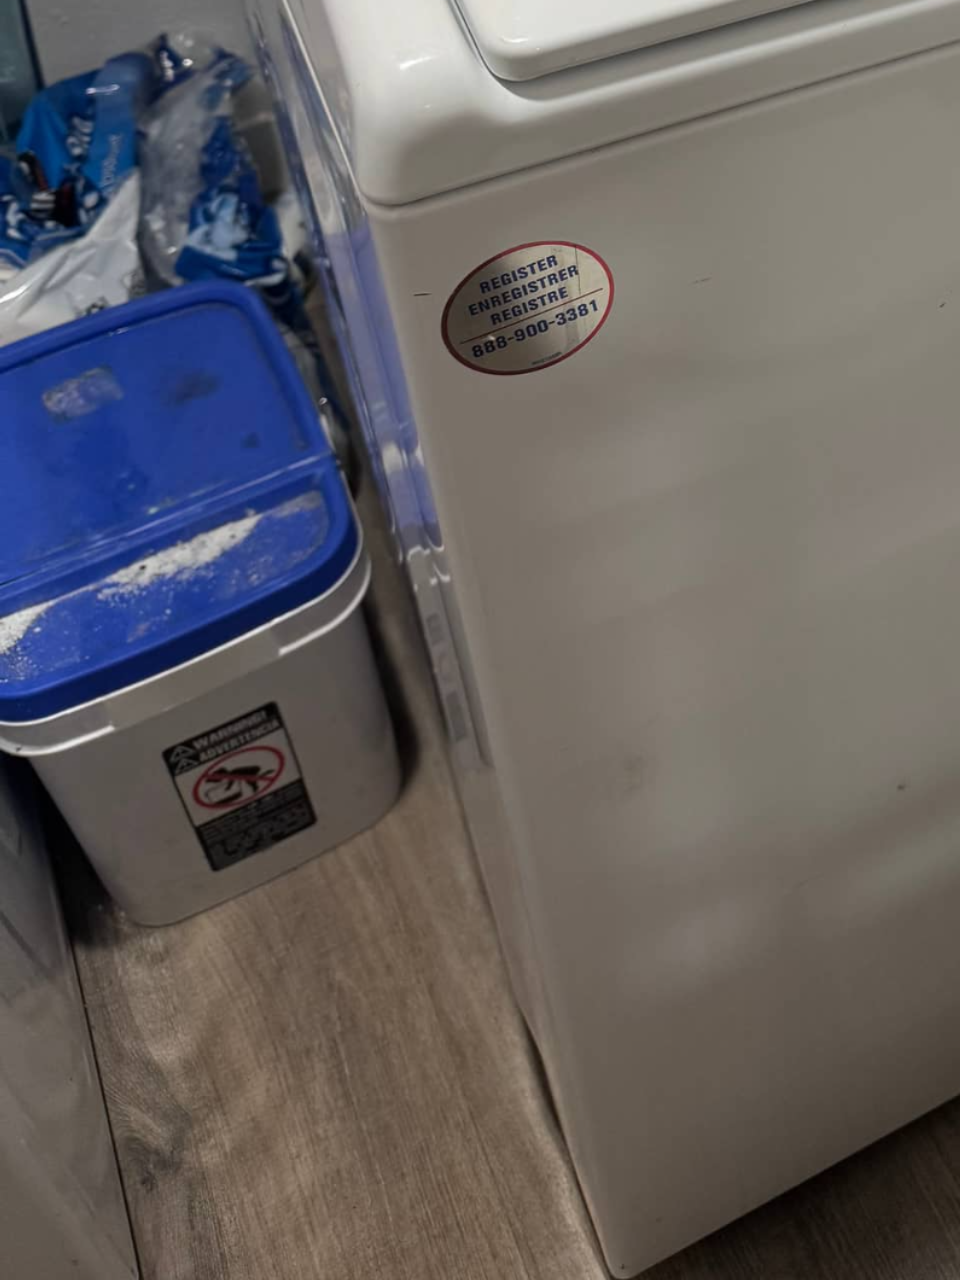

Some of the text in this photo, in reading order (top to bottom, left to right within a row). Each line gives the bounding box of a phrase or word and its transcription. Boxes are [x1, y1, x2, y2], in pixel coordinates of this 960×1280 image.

[468, 265, 579, 316] ENREGISTRER
[479, 255, 558, 294] REGISTER
[471, 300, 599, 358] 888-900-3381
[490, 287, 569, 326] REGISTRE
